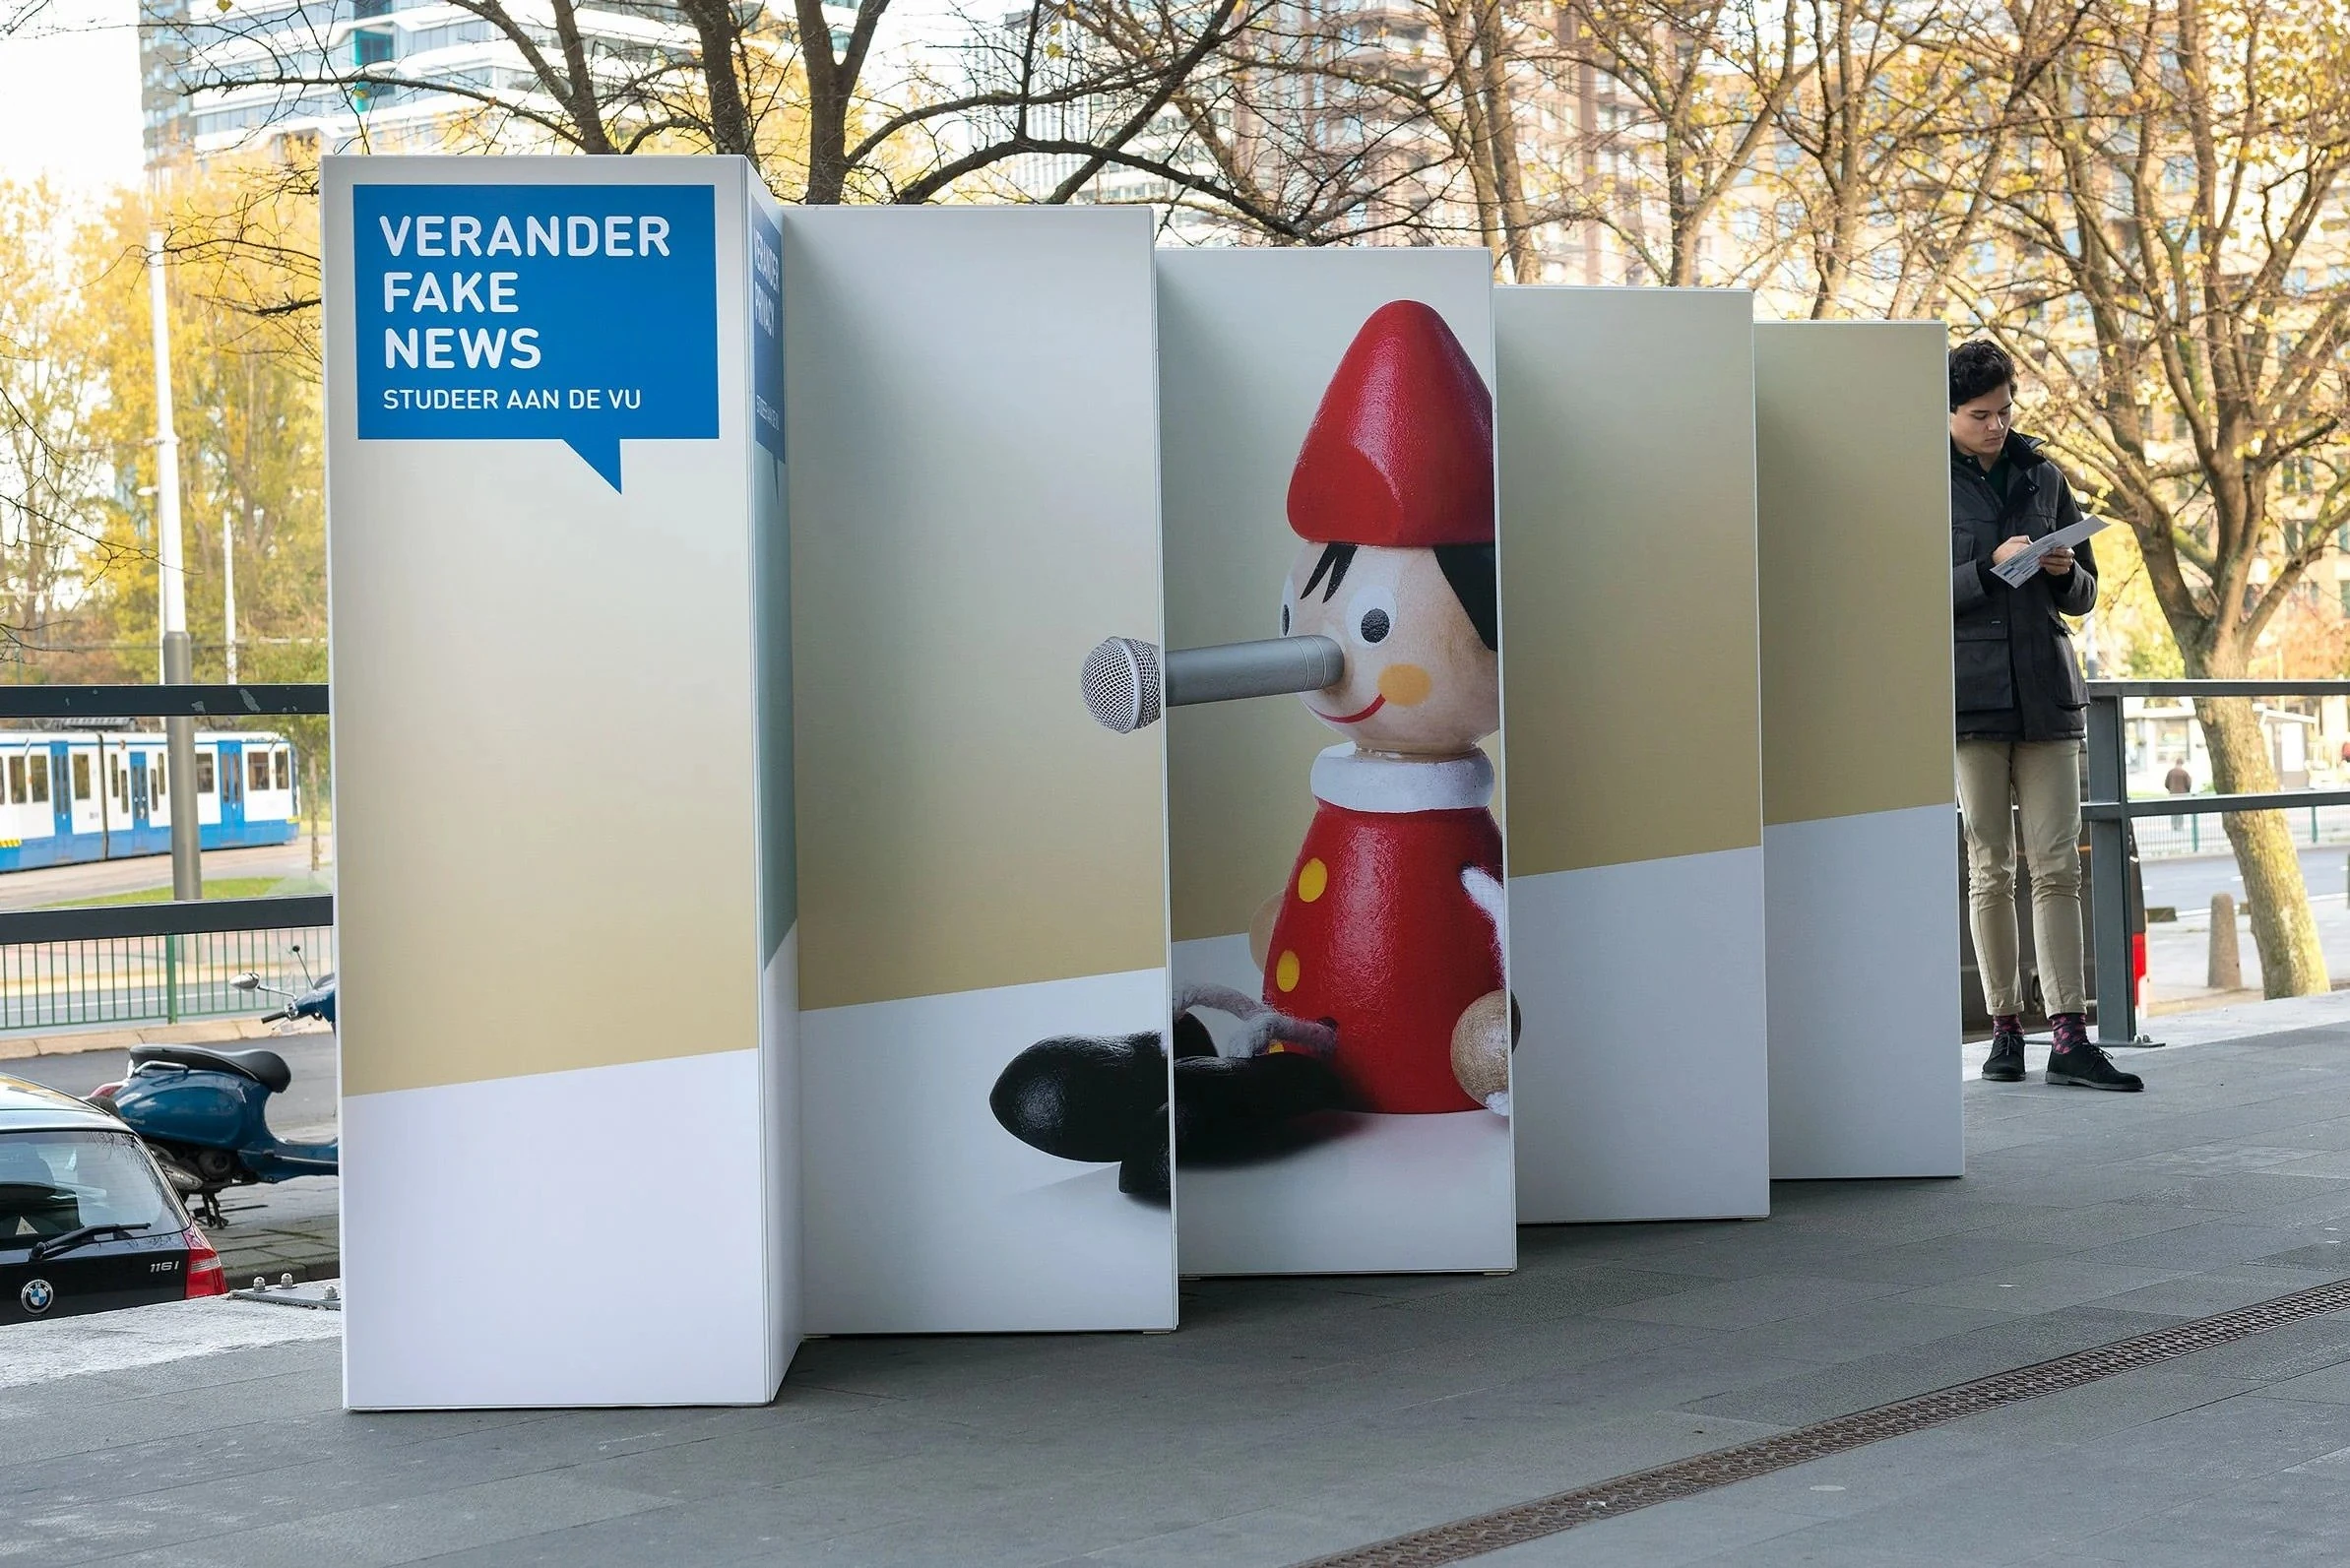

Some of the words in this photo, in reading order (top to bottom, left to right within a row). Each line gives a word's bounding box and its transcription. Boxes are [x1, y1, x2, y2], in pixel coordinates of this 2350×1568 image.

[379, 216, 670, 257] VERANDER
[384, 272, 519, 313] FAKE
[385, 328, 541, 369] NEWS
[383, 389, 499, 409] STUDEER
[506, 389, 559, 409] AAN
[569, 389, 601, 409] DE
[607, 389, 642, 409] VU
